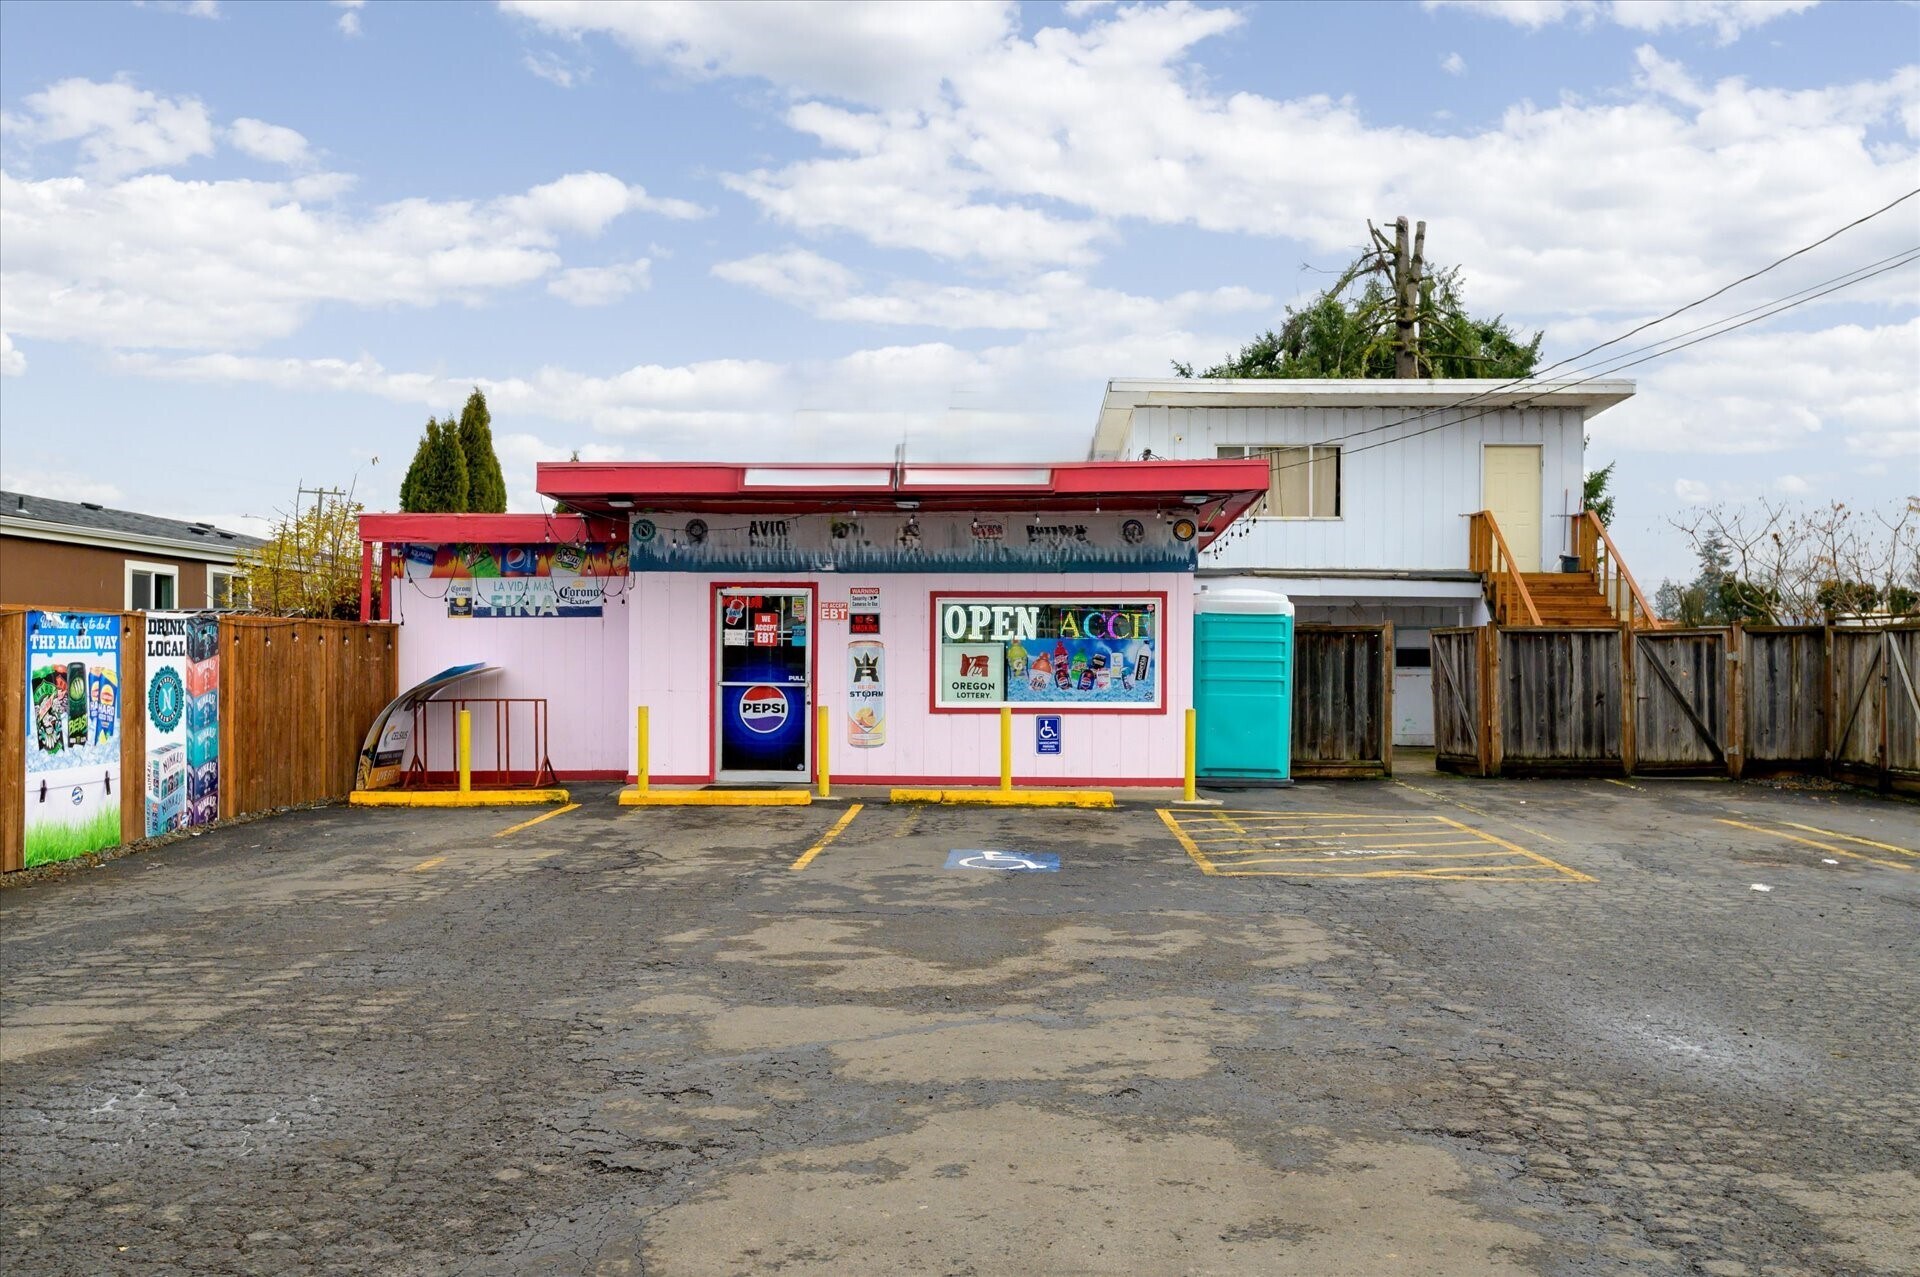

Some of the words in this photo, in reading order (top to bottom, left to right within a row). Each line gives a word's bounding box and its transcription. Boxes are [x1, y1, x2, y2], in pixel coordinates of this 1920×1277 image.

[494, 581, 505, 591] LA
[508, 581, 529, 592] VIDA
[560, 586, 600, 599] Corona
[491, 595, 560, 616] FINA
[822, 609, 847, 618] EBT
[148, 619, 186, 635] DRINK
[945, 605, 1040, 640] OPEN
[30, 635, 56, 650] THE
[58, 635, 92, 650] HARD
[94, 635, 118, 650] WAY
[757, 632, 774, 643] EBT
[148, 641, 186, 656] LOCAL
[952, 682, 995, 690] OREGON
[850, 690, 884, 699] STORM
[98, 703, 115, 716] HARD
[743, 703, 786, 714] PEPSI
